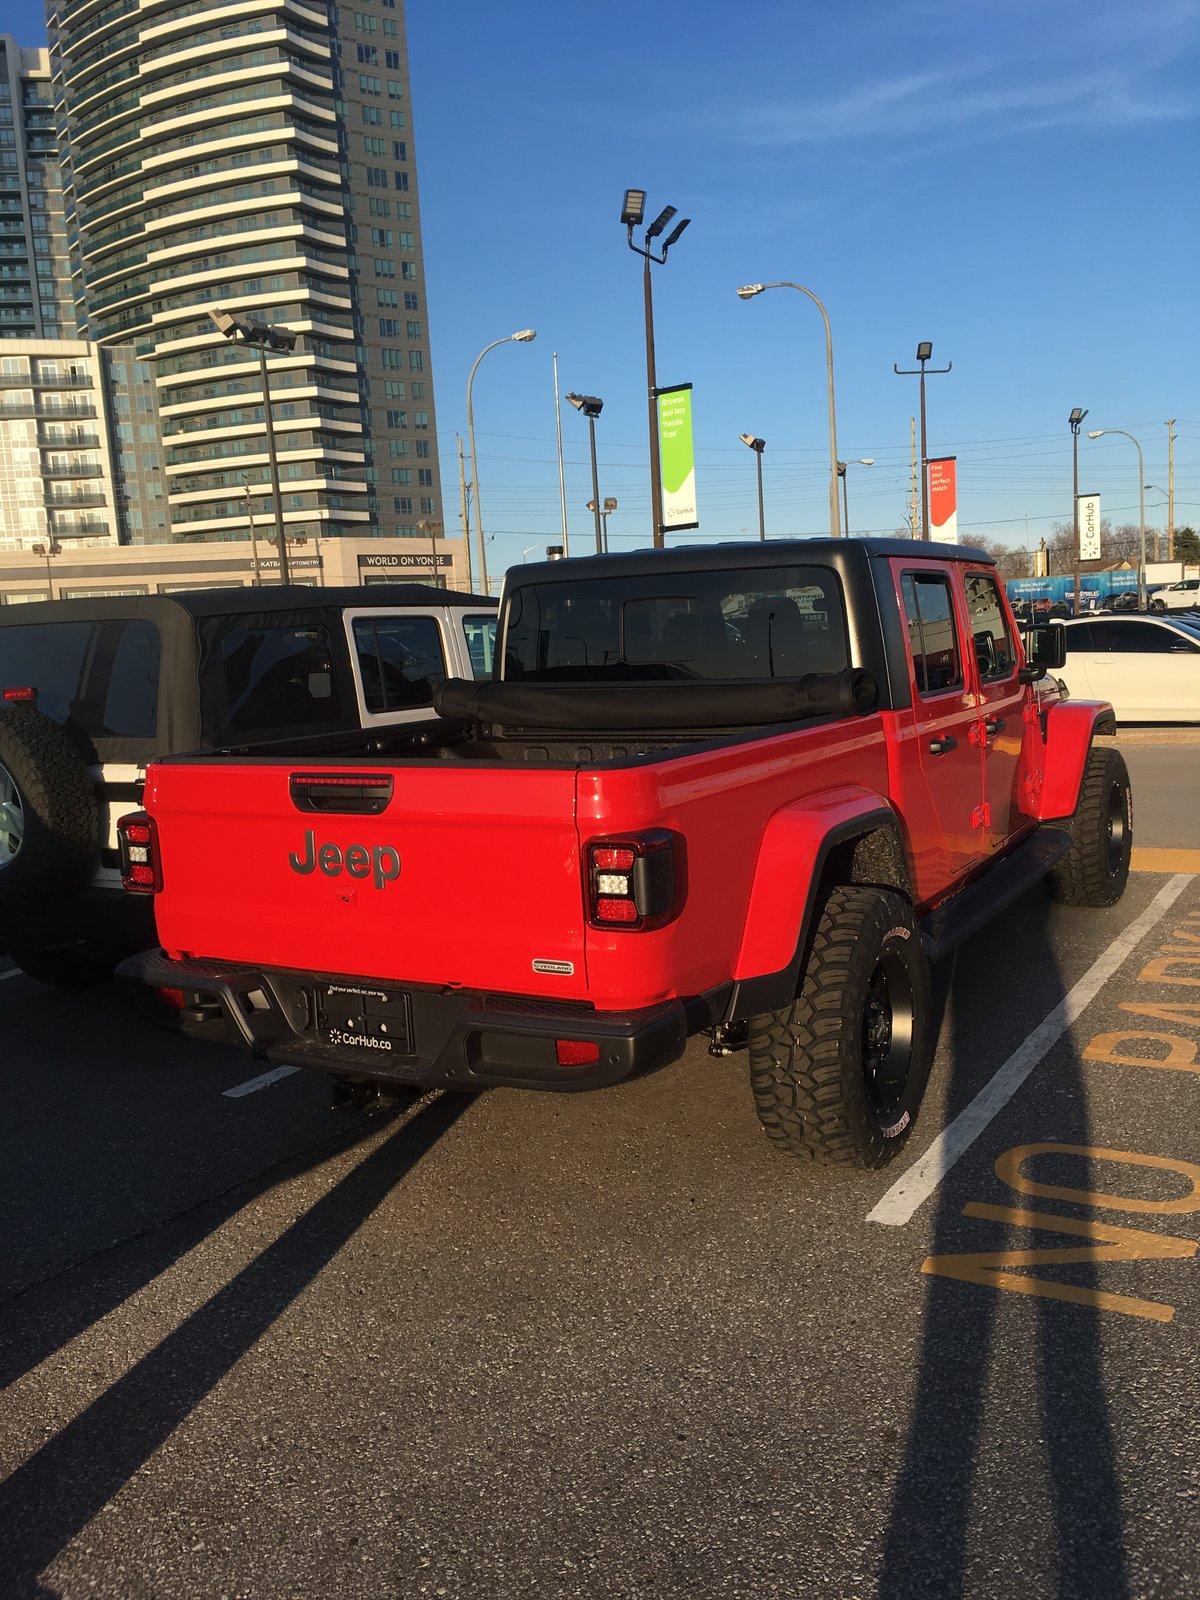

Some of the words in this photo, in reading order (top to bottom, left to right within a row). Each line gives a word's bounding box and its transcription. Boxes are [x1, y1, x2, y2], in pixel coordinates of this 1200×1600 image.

[662, 408, 674, 417] and
[674, 407, 686, 417] buy
[1085, 502, 1095, 538] CarHub
[366, 556, 398, 565] WORLD
[400, 556, 414, 565] ON
[288, 829, 401, 890] Jeep
[533, 963, 572, 971] OVERLAND
[342, 1033, 392, 1050] CarHub.ca
[919, 1143, 1200, 1323] NO
